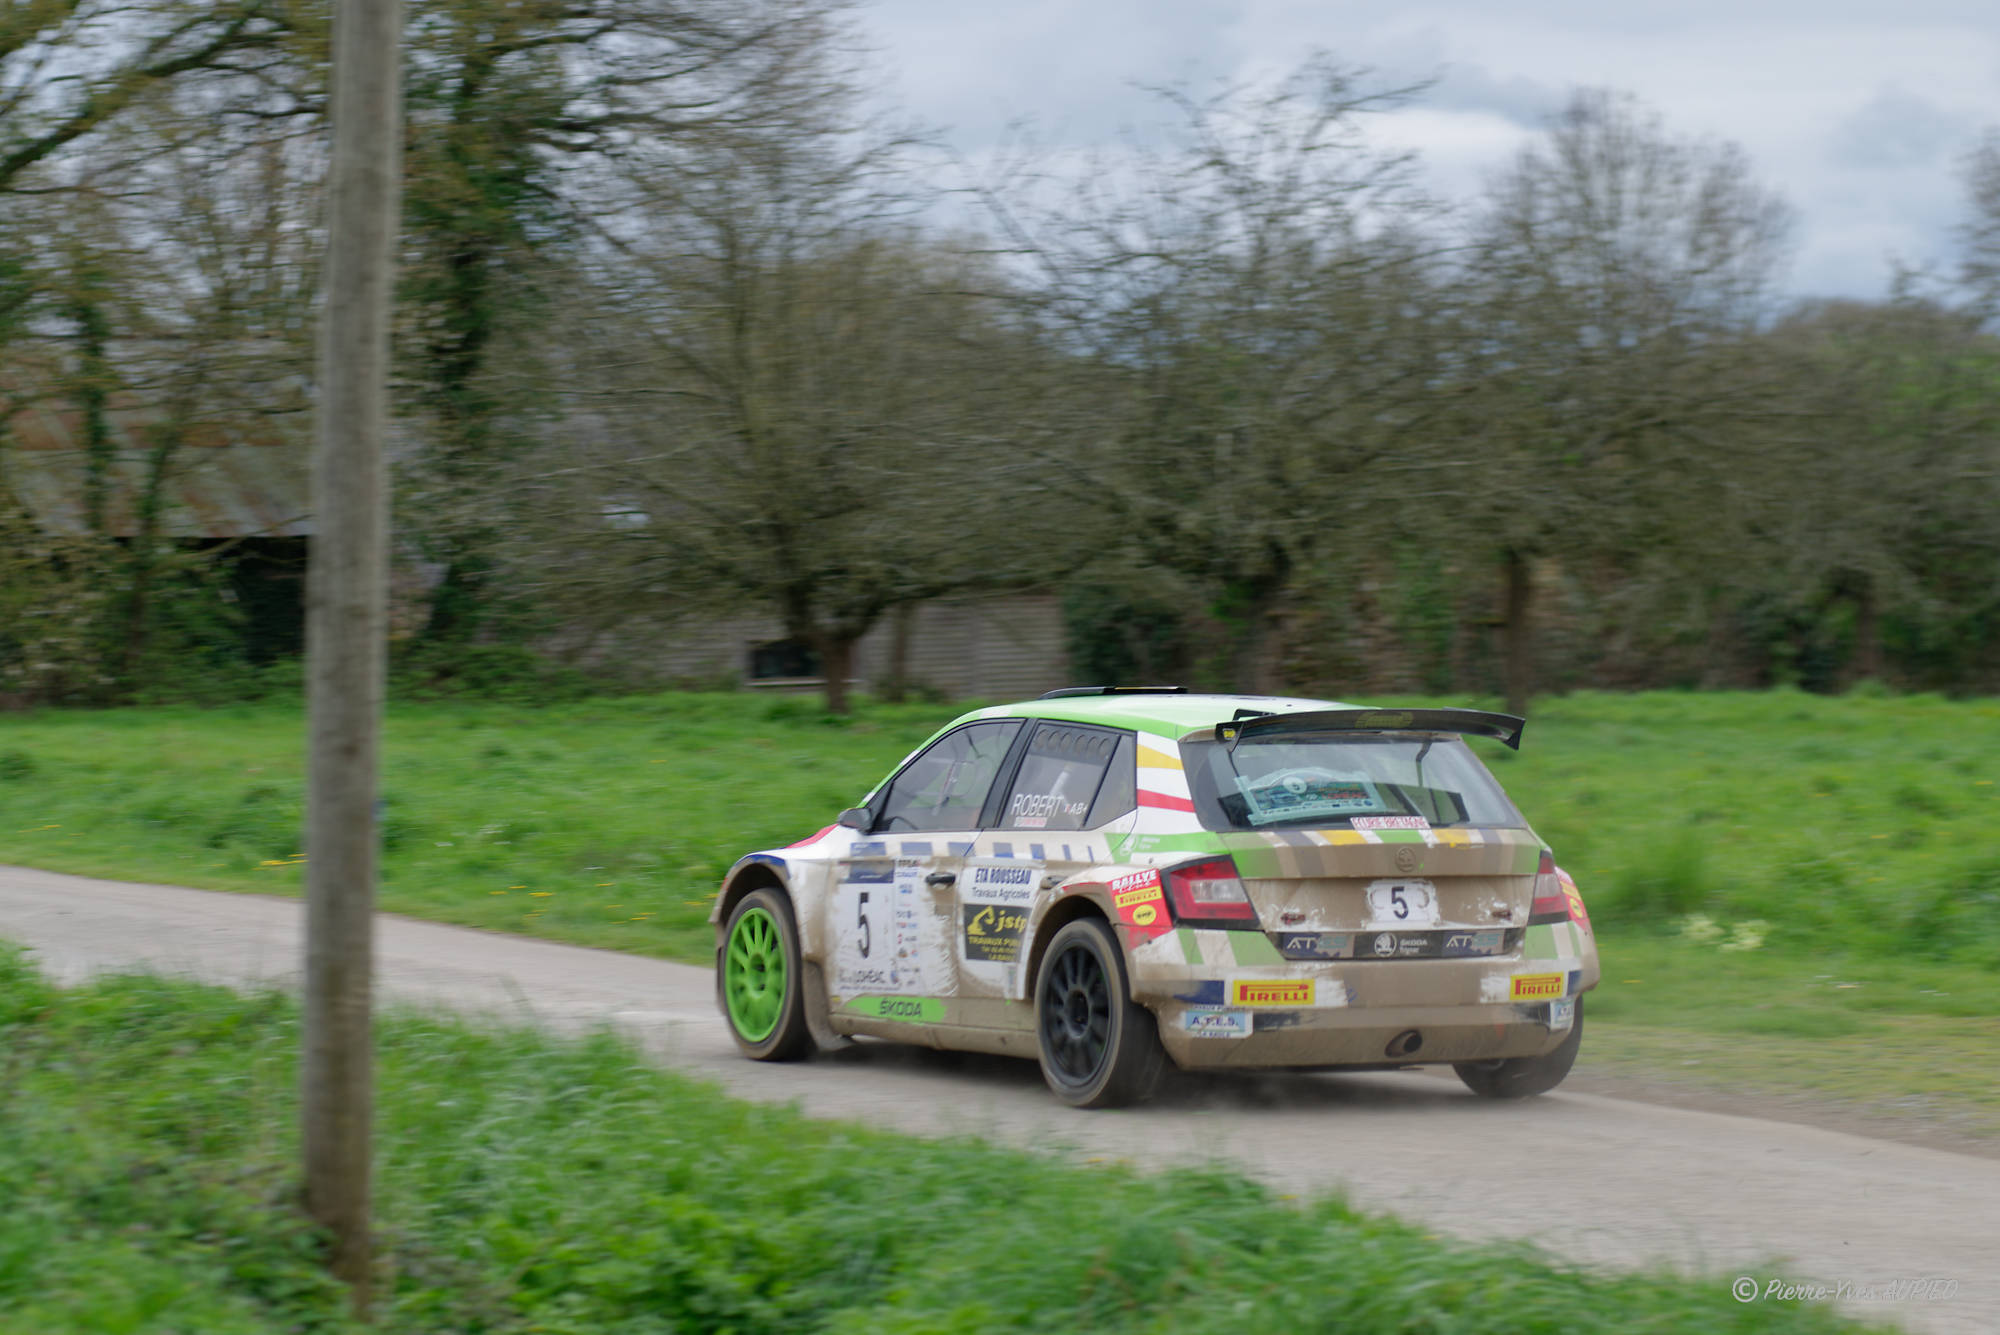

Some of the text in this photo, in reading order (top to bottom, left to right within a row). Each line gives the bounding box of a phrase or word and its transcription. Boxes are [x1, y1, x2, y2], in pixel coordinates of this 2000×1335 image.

[1010, 793, 1065, 817] ROBERT
[975, 868, 1033, 885] ETA ROUSSEAU
[1112, 869, 1158, 891] RALLYE
[972, 886, 1031, 901] Travaux Agricoles
[1391, 886, 1409, 920] 5
[857, 891, 871, 960] 5
[1239, 984, 1309, 1002] PIRELLI
[1515, 976, 1561, 996] PIRELLI
